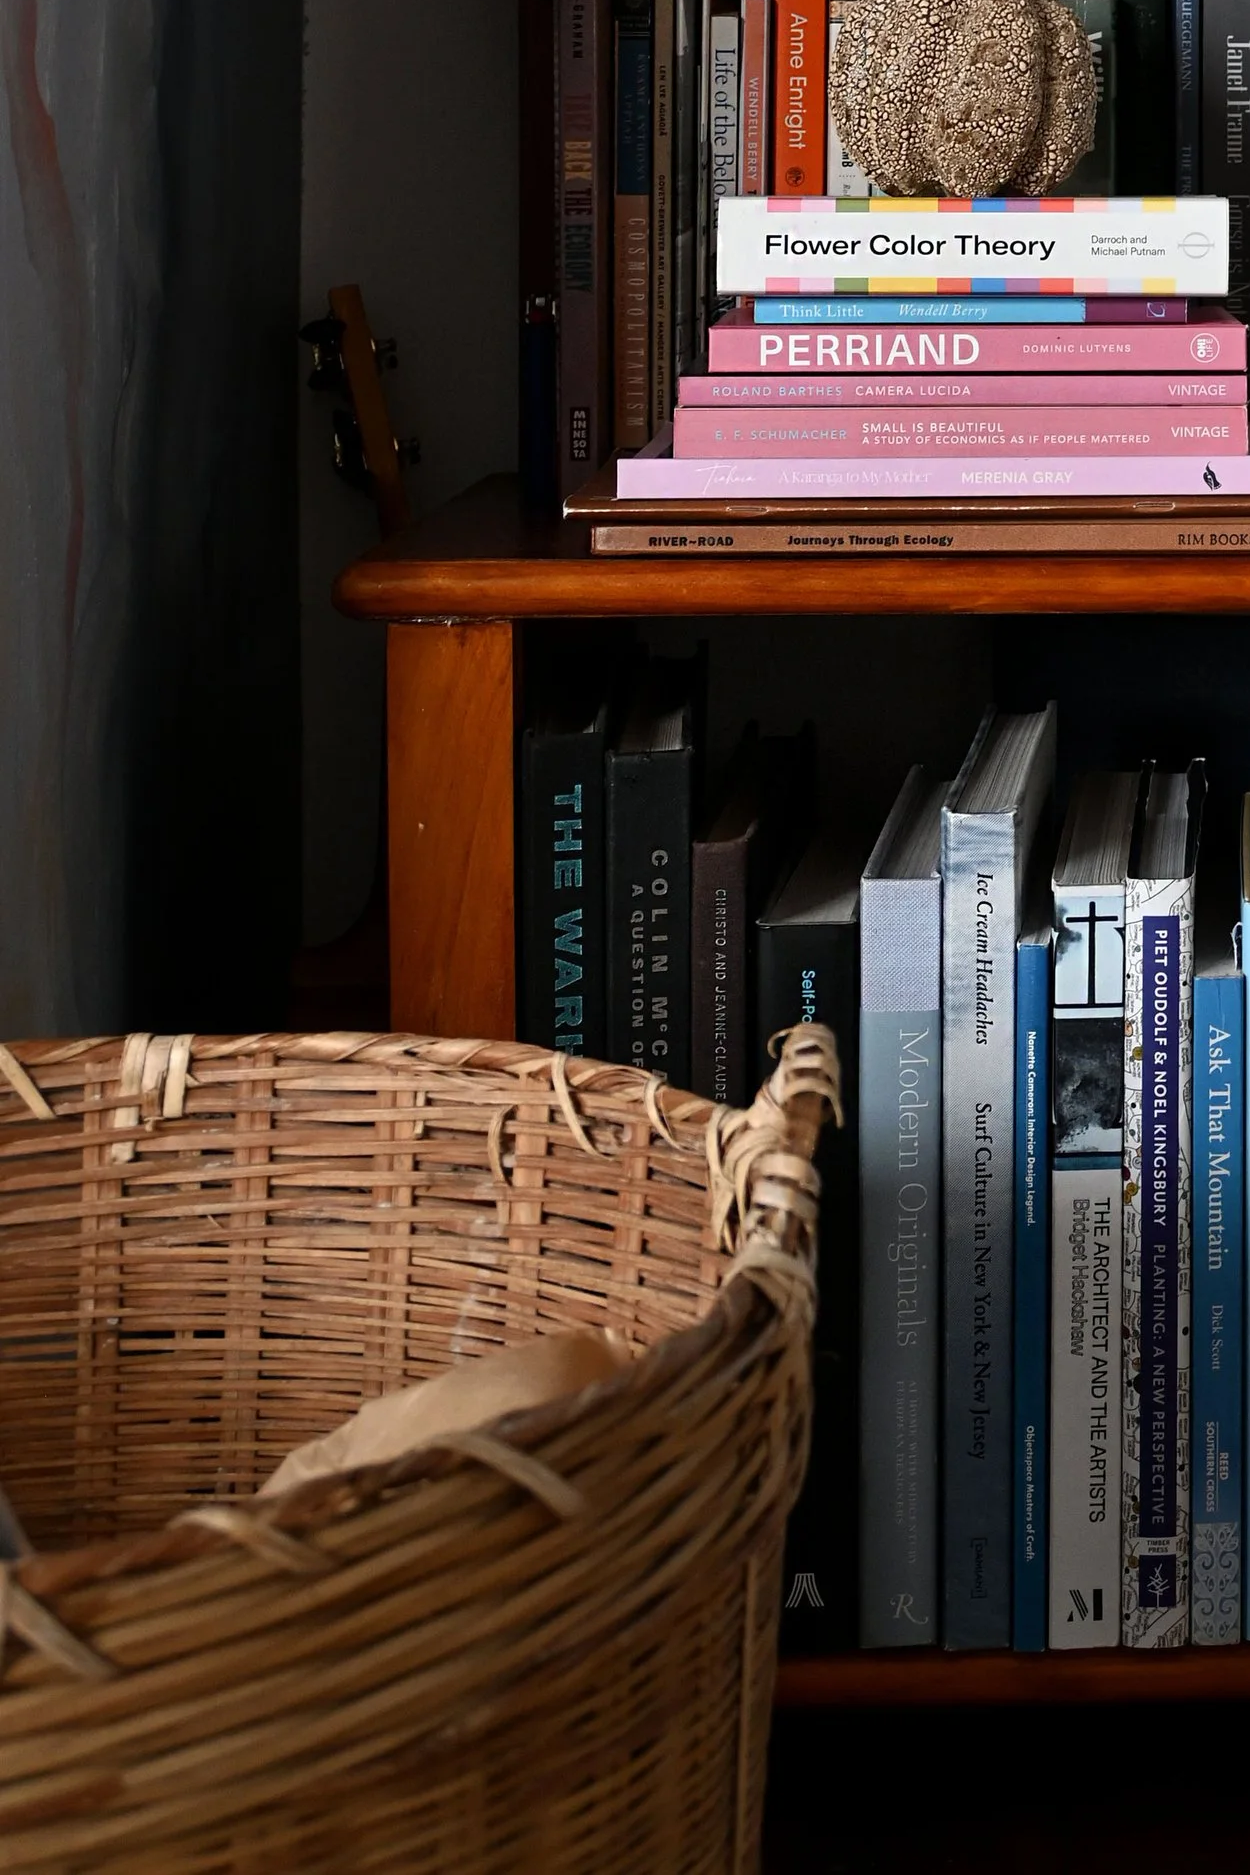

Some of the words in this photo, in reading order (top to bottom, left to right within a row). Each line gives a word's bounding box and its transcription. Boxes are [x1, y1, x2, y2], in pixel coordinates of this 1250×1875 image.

[789, 13, 808, 69] Anne
[784, 76, 807, 150] Enright
[765, 234, 862, 256] Flower
[869, 234, 947, 256] Color
[954, 234, 1056, 261] Theory
[1091, 234, 1128, 245] Darroch
[1129, 235, 1148, 245] and
[1091, 246, 1128, 256] Michael
[1130, 246, 1166, 256] Putnam
[760, 333, 980, 367] PERRIAND
[1022, 344, 1075, 354] DOMINIC
[1079, 344, 1131, 353] LUTYENS
[862, 422, 907, 435] SMALL
[912, 422, 924, 433] IS
[929, 422, 1004, 433] BEAUTIFUL
[787, 535, 845, 549] Journeys
[848, 534, 900, 551] Through
[903, 534, 955, 550] Ecology
[553, 783, 583, 890] THE
[651, 849, 669, 973] COLIN
[1154, 929, 1168, 967] PIET
[1154, 971, 1168, 1046] OUDOLF
[1154, 1051, 1168, 1065] &
[1208, 1024, 1232, 1075] Ask
[1153, 1071, 1168, 1118] NOEL
[1208, 1083, 1232, 1144] That
[1153, 1124, 1167, 1226] KINGSBURY
[1093, 1196, 1111, 1237] THE
[1208, 1151, 1231, 1270] Mountain
[1092, 1241, 1110, 1352] ARCHITECT
[1090, 1356, 1109, 1399] AND
[1090, 1401, 1108, 1442] THE
[1088, 1444, 1107, 1523] ARTISTS
